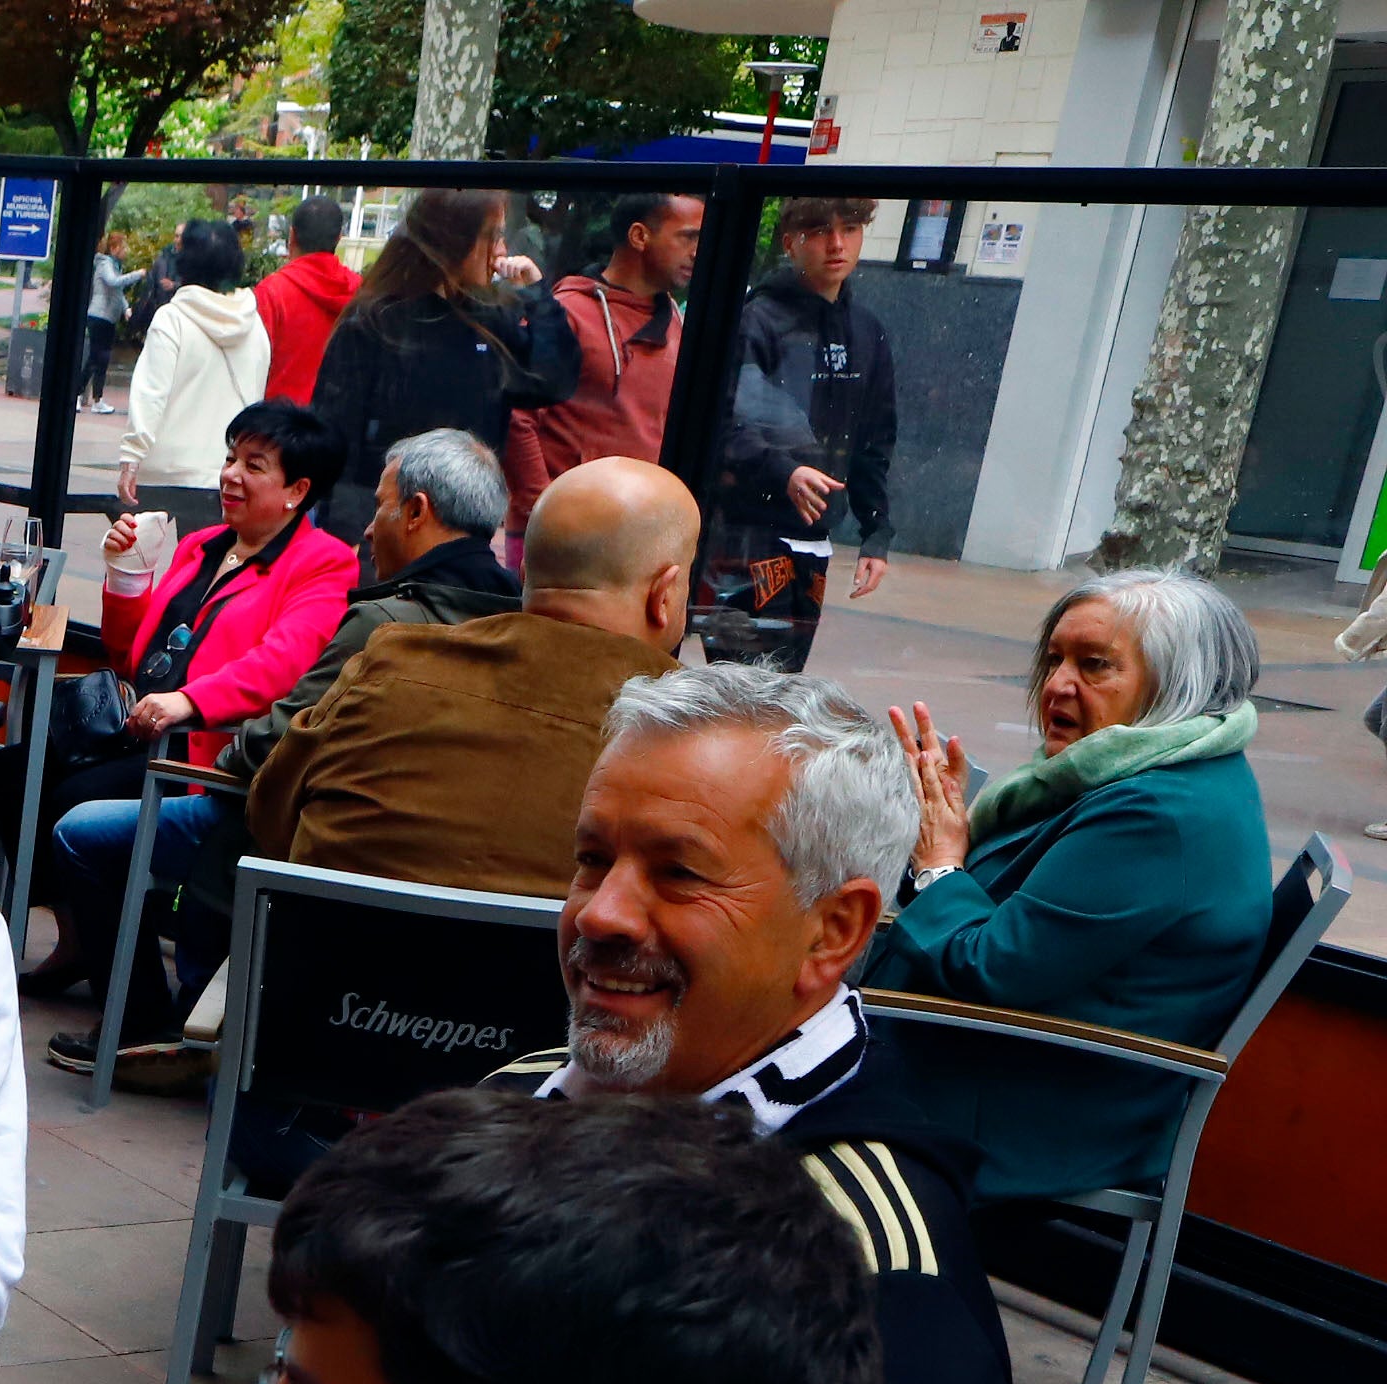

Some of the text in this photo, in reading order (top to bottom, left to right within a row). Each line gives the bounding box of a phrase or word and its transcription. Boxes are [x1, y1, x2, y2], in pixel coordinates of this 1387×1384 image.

[12, 194, 43, 204] OFICINA
[6, 202, 47, 211] MUNICIPAL
[2, 210, 50, 220] DE TURISMO
[329, 992, 515, 1053] Schweppes
